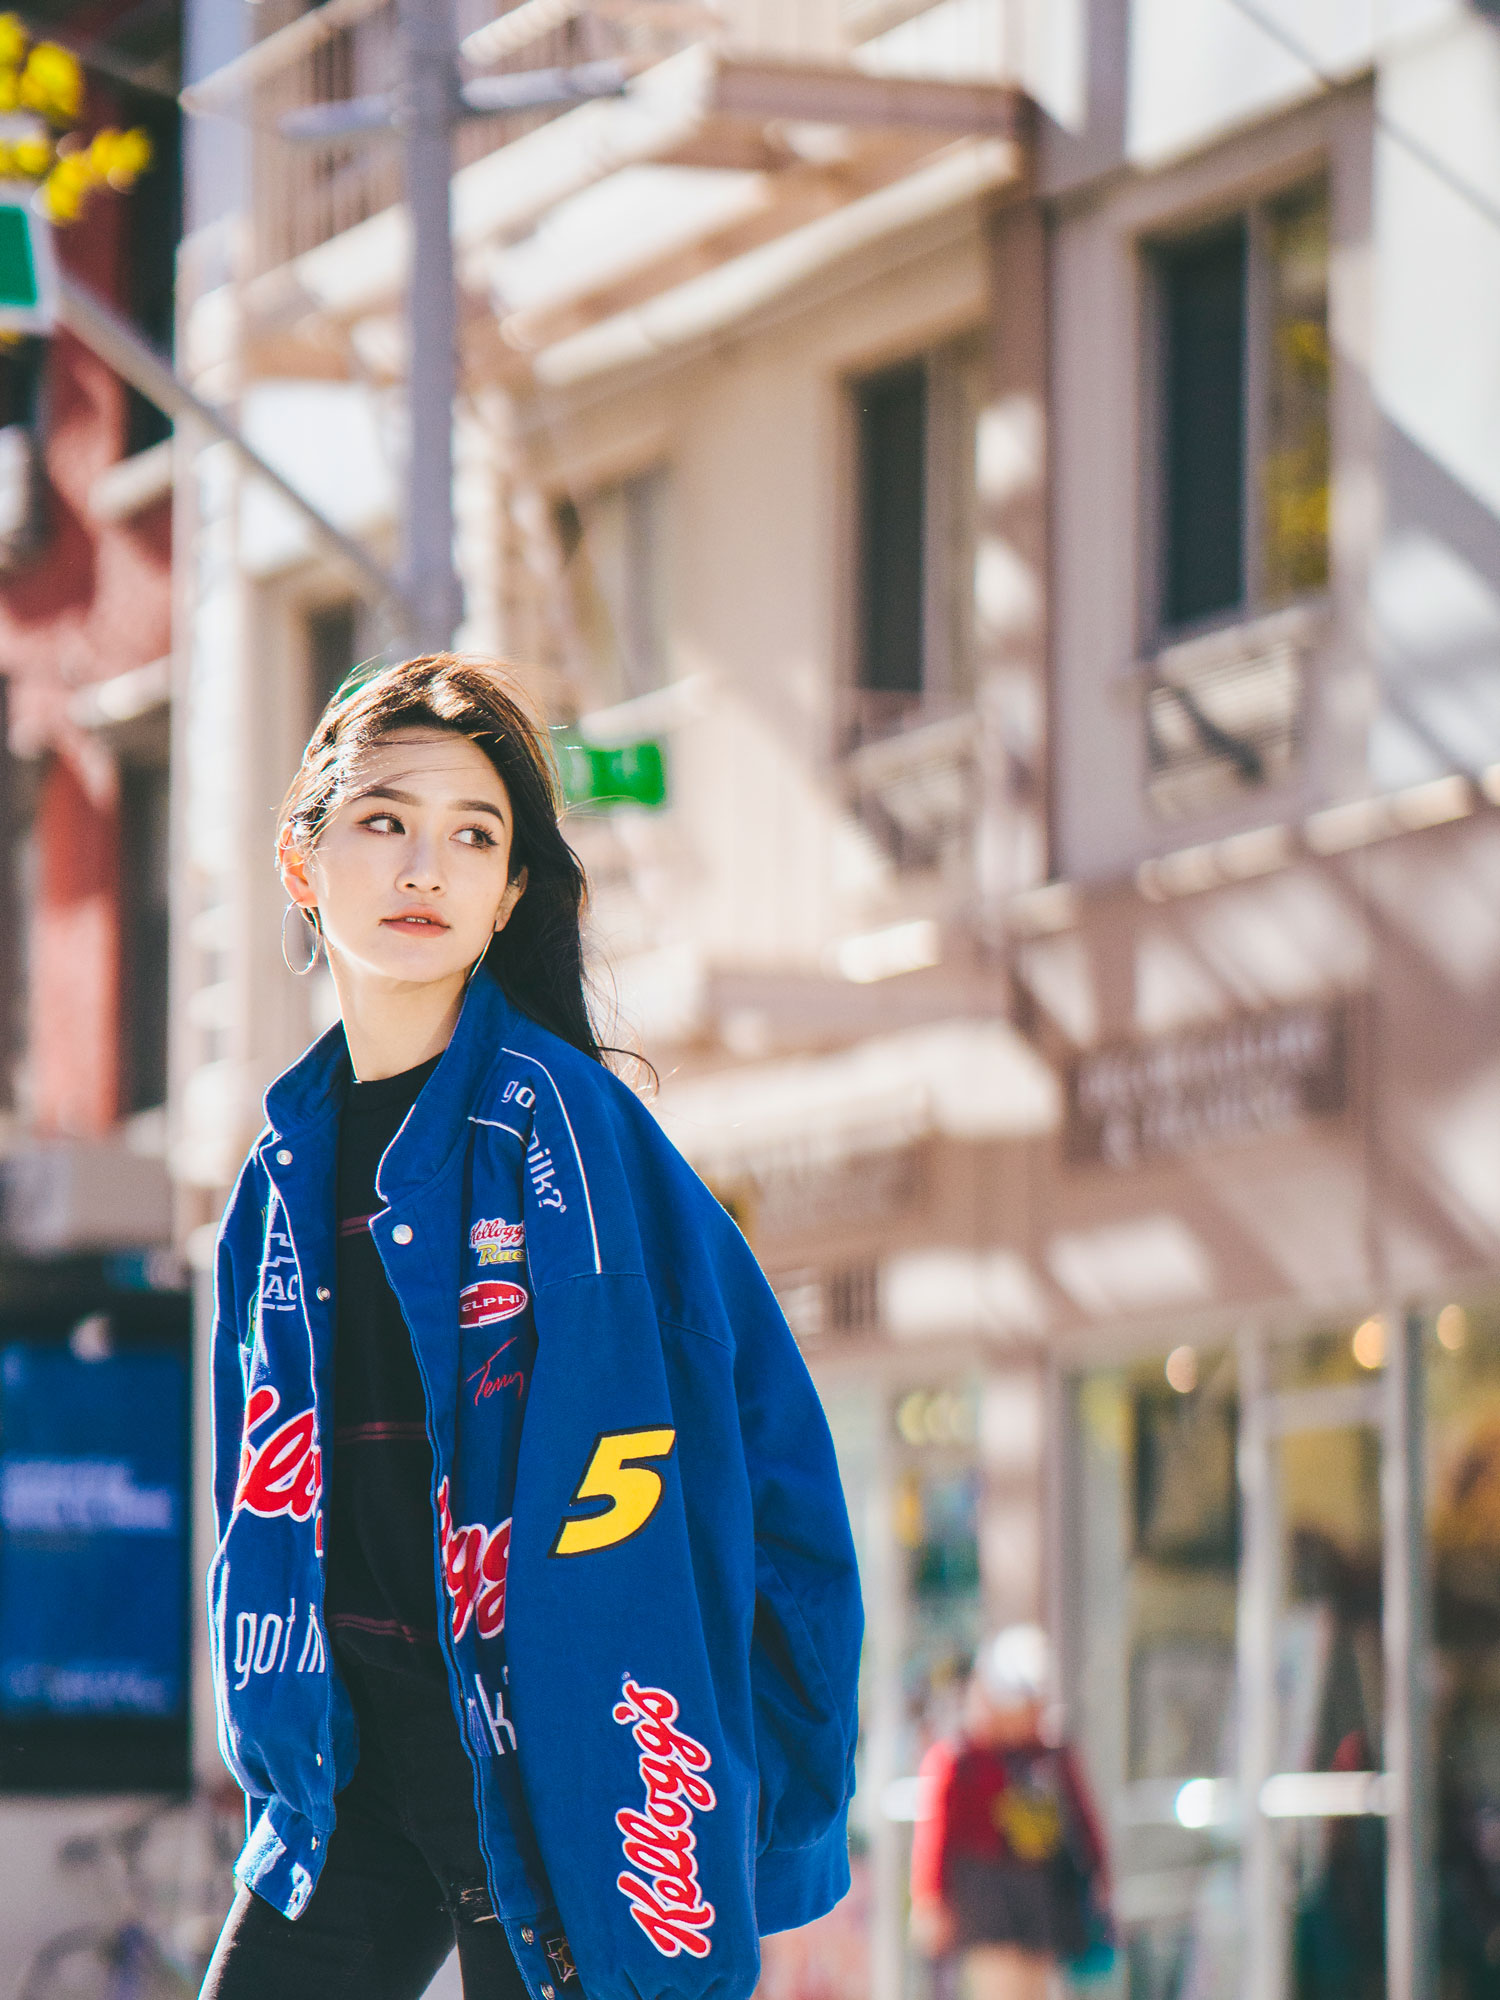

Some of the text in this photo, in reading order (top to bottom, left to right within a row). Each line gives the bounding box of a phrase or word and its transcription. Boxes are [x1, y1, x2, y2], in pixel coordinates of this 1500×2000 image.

[501, 1081, 536, 1114] go
[469, 1218, 526, 1249] Kellogg
[478, 1243, 526, 1266] Rac
[461, 1294, 522, 1312] ELPHI
[550, 1424, 676, 1558] 5
[612, 1679, 717, 1958] Kellogg's
